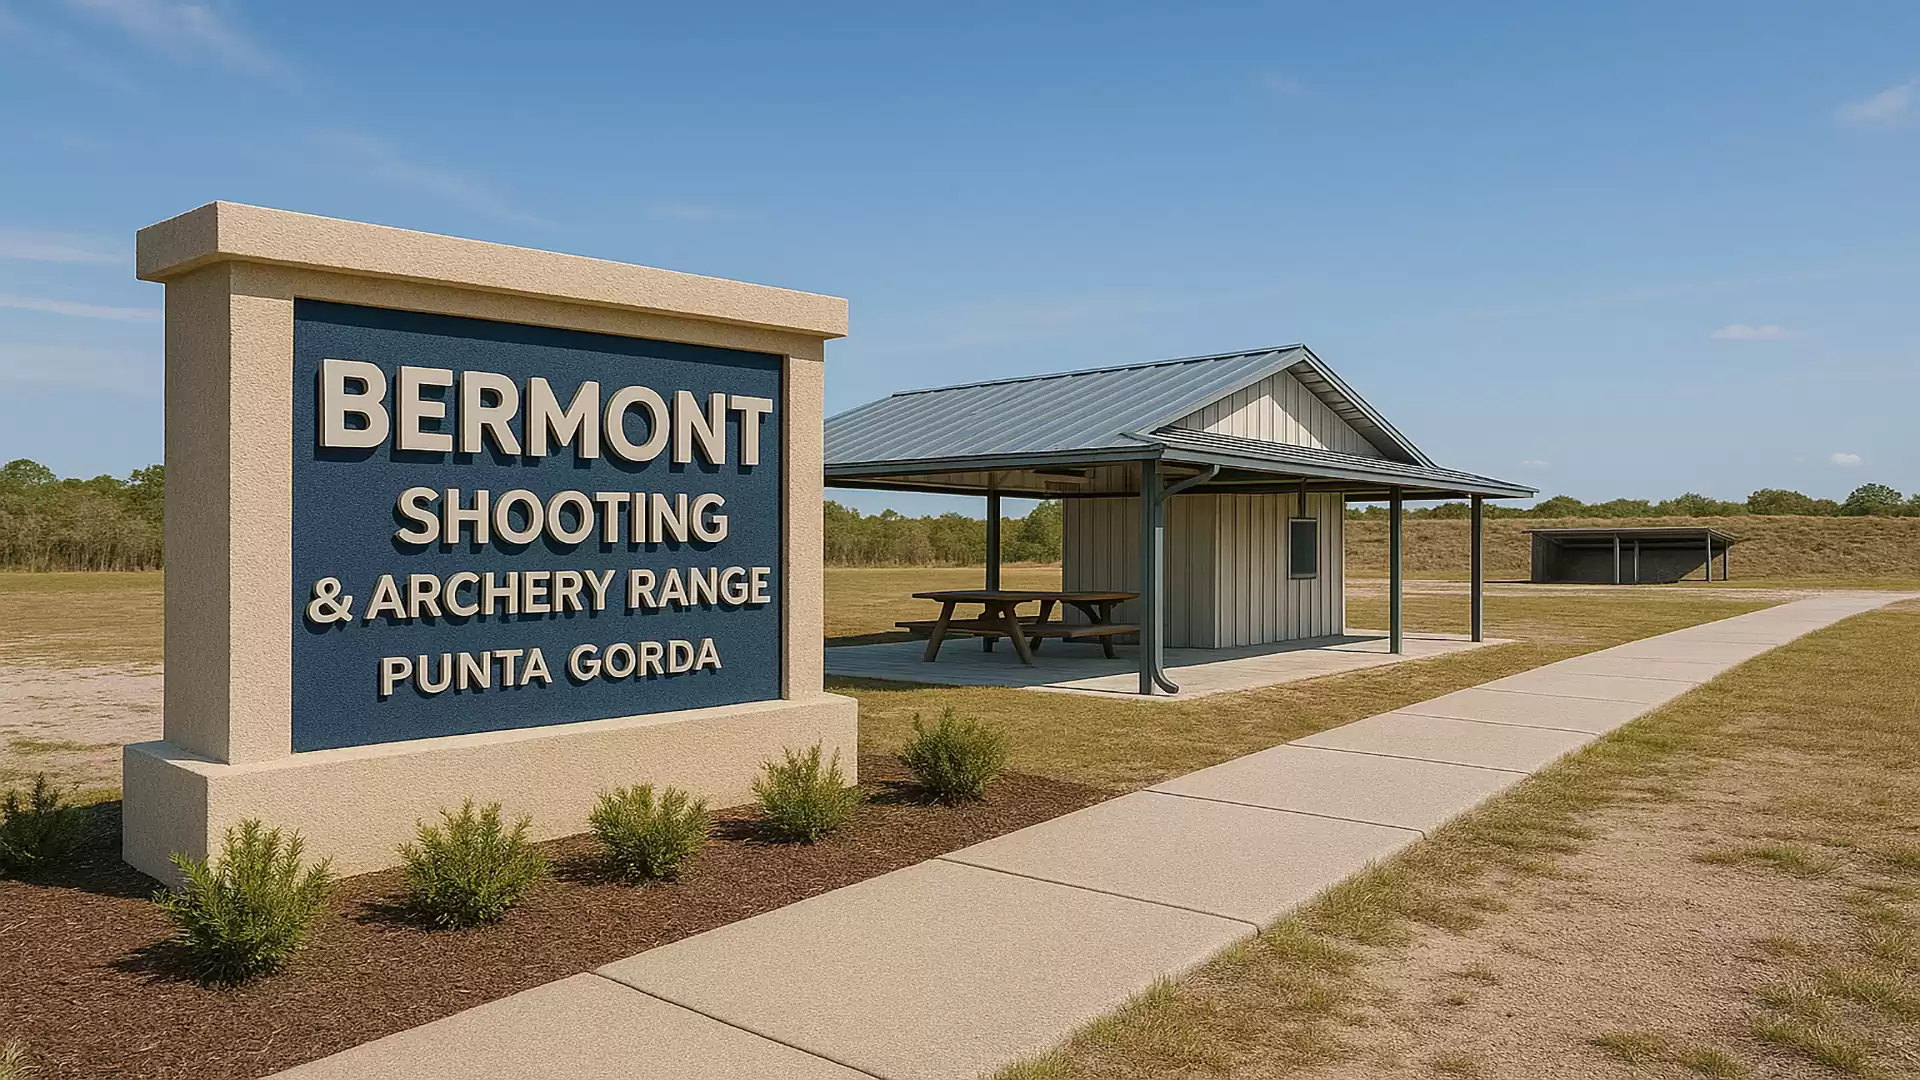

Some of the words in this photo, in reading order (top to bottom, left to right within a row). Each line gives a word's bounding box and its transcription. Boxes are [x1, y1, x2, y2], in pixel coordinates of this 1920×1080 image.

[319, 358, 773, 466] BERMONT
[394, 487, 729, 545] SHOOTING
[306, 577, 353, 624] &
[364, 570, 617, 620] ARCHERY
[627, 567, 771, 609] RANGE
[379, 647, 552, 697] PUNTA
[568, 637, 722, 681] GORDA
